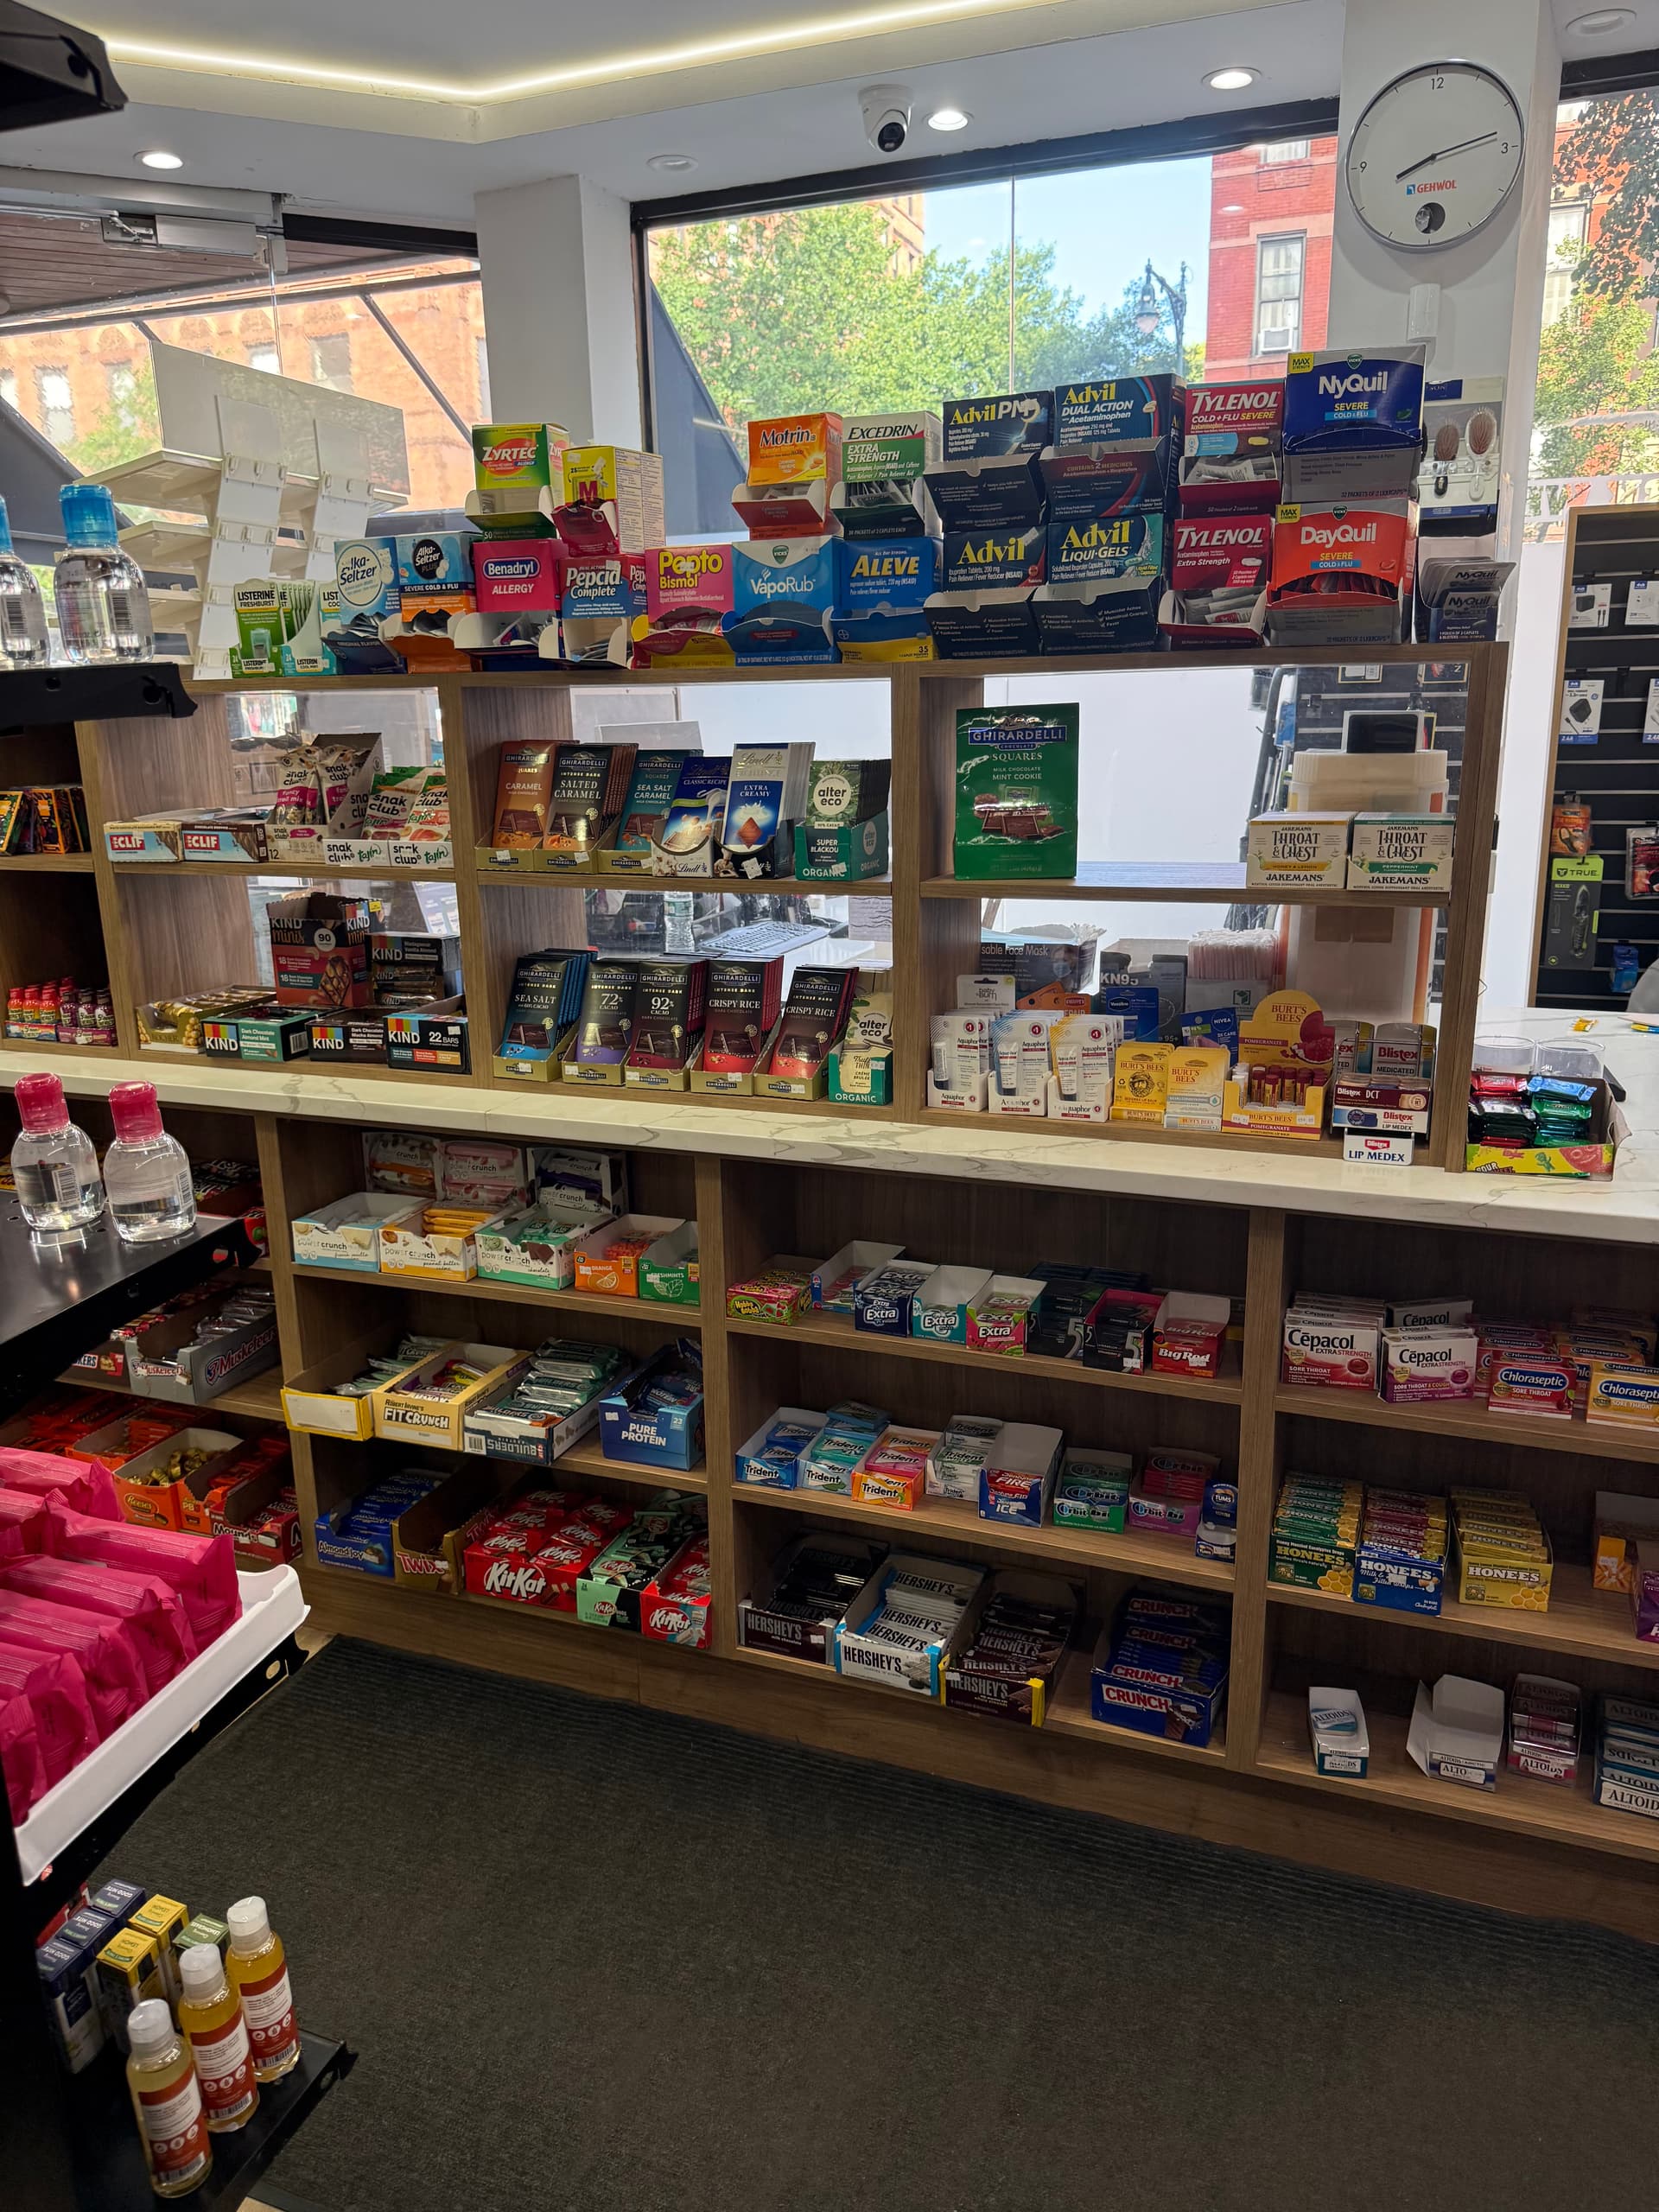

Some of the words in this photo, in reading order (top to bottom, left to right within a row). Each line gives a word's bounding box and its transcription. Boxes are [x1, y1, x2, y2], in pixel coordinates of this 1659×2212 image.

[1430, 77, 1444, 90] 12
[1501, 143, 1509, 154] 3
[1360, 162, 1367, 173] 9
[1417, 180, 1457, 193] GEHWOL
[1293, 358, 1310, 366] MAX
[1319, 372, 1389, 397] NyQuil
[1062, 384, 1116, 405] Advil
[1062, 405, 1091, 416] DUAL
[1092, 400, 1133, 412] ACTION
[1191, 390, 1280, 415] TYLENOL
[1334, 402, 1369, 411] SEVERE
[949, 404, 995, 425] Advil
[1192, 414, 1216, 423] COLD
[760, 428, 810, 448] Motrin
[849, 424, 917, 441] EXCEDRIN
[483, 445, 536, 463] ZYRTEC
[848, 444, 878, 454] EXTRA
[847, 451, 899, 464] STRENGTH
[1061, 519, 1130, 550] Advil
[1176, 525, 1265, 550] TYLENOL
[1300, 523, 1376, 549] DayQuil
[417, 546, 435, 556] Alka-
[957, 537, 1025, 565] Advil
[1320, 552, 1353, 561] SEVERE
[416, 552, 440, 566] Seltzer
[1196, 557, 1230, 567] Strength
[488, 562, 535, 576] Benadryl
[850, 556, 919, 578] ALEVE
[340, 566, 378, 585] Seltzer
[492, 584, 534, 594] ALLERGY
[659, 577, 698, 589] Bismol
[750, 578, 813, 598] VapoRub
[238, 590, 275, 601] LISTERINE
[571, 586, 616, 599] Complete
[1448, 596, 1491, 610] NyQuil
[973, 729, 1063, 741] GHIRARDELLI
[560, 780, 598, 789] SALTED
[555, 790, 601, 799] CARAMEL
[818, 786, 847, 798] alter
[373, 794, 407, 806] snak
[821, 798, 841, 806] eco
[369, 803, 398, 816] club
[121, 836, 143, 847] CLIF
[194, 835, 218, 846] CLIF
[1272, 831, 1320, 847] THROAT
[1376, 830, 1427, 846] THROAT
[327, 842, 352, 852] snak
[1272, 847, 1281, 858] &
[1281, 843, 1319, 861] CHEST
[1377, 847, 1385, 858] &
[1386, 843, 1424, 861] CHEST
[270, 849, 278, 859] 12
[1369, 876, 1429, 885] JAKEMANS
[270, 918, 302, 929] KIND
[372, 949, 403, 961] KIND
[1026, 945, 1048, 956] Mask
[601, 994, 619, 1005] 72
[652, 997, 670, 1010] 92
[709, 1000, 738, 1008] CRISPY
[740, 1001, 760, 1009] RICE
[786, 1007, 813, 1015] CRISPY
[815, 1007, 836, 1017] RICE
[1272, 1004, 1307, 1014] BURT'S
[859, 1020, 887, 1029] alter
[1276, 1014, 1301, 1023] BEES
[388, 1030, 420, 1044] KIND
[429, 1032, 441, 1042] 22
[861, 1028, 881, 1037] eco
[205, 1037, 238, 1051] KIND
[313, 1037, 344, 1050] KIND
[1378, 1047, 1418, 1061] Blistex
[1120, 1062, 1145, 1071] BURT'S
[1376, 1066, 1414, 1075] MEDICATED
[836, 1093, 877, 1103] ORGANIC
[1337, 1087, 1361, 1097] Blistex
[1365, 1090, 1379, 1100] DCT
[1382, 1112, 1413, 1121] Blistex
[1349, 1150, 1365, 1160] LIP
[1367, 1151, 1404, 1161] MEDEX
[866, 1308, 896, 1321] Extra
[925, 1316, 957, 1329] Extra
[979, 1326, 1011, 1337] Extra
[1159, 1348, 1179, 1360] Big
[1501, 1372, 1564, 1386] Chloraseptic
[629, 1422, 657, 1435] PURE
[622, 1429, 666, 1446] PROTEIN
[890, 1437, 931, 1448] Trident
[825, 1439, 864, 1451] Trident
[878, 1451, 918, 1463] Trident
[745, 1465, 779, 1478] Trident
[806, 1470, 841, 1483] Trident
[995, 1477, 1032, 1487] FIRE
[862, 1483, 898, 1497] Trident
[996, 1503, 1018, 1515] ICE
[1057, 1503, 1087, 1516] Orbit
[1132, 1503, 1165, 1519] Orbit
[318, 1540, 340, 1556] Almond
[1276, 1545, 1345, 1566] HONEES
[1361, 1560, 1433, 1580] HONEES
[1467, 1567, 1539, 1582] HONEES
[486, 1562, 546, 1597] KitKat
[896, 1573, 955, 1595] HERSHEY'S
[651, 1611, 691, 1633] KitKat
[747, 1613, 802, 1639] HERSHEY'S
[880, 1609, 942, 1631] HERSHEY'S
[868, 1624, 929, 1651] HERSHEY'S
[843, 1645, 901, 1673] HERSHEY'S
[1112, 1665, 1181, 1687] CRUNCH
[1105, 1688, 1170, 1709] CRUNCH
[1523, 1758, 1562, 1775] ALTOIDS
